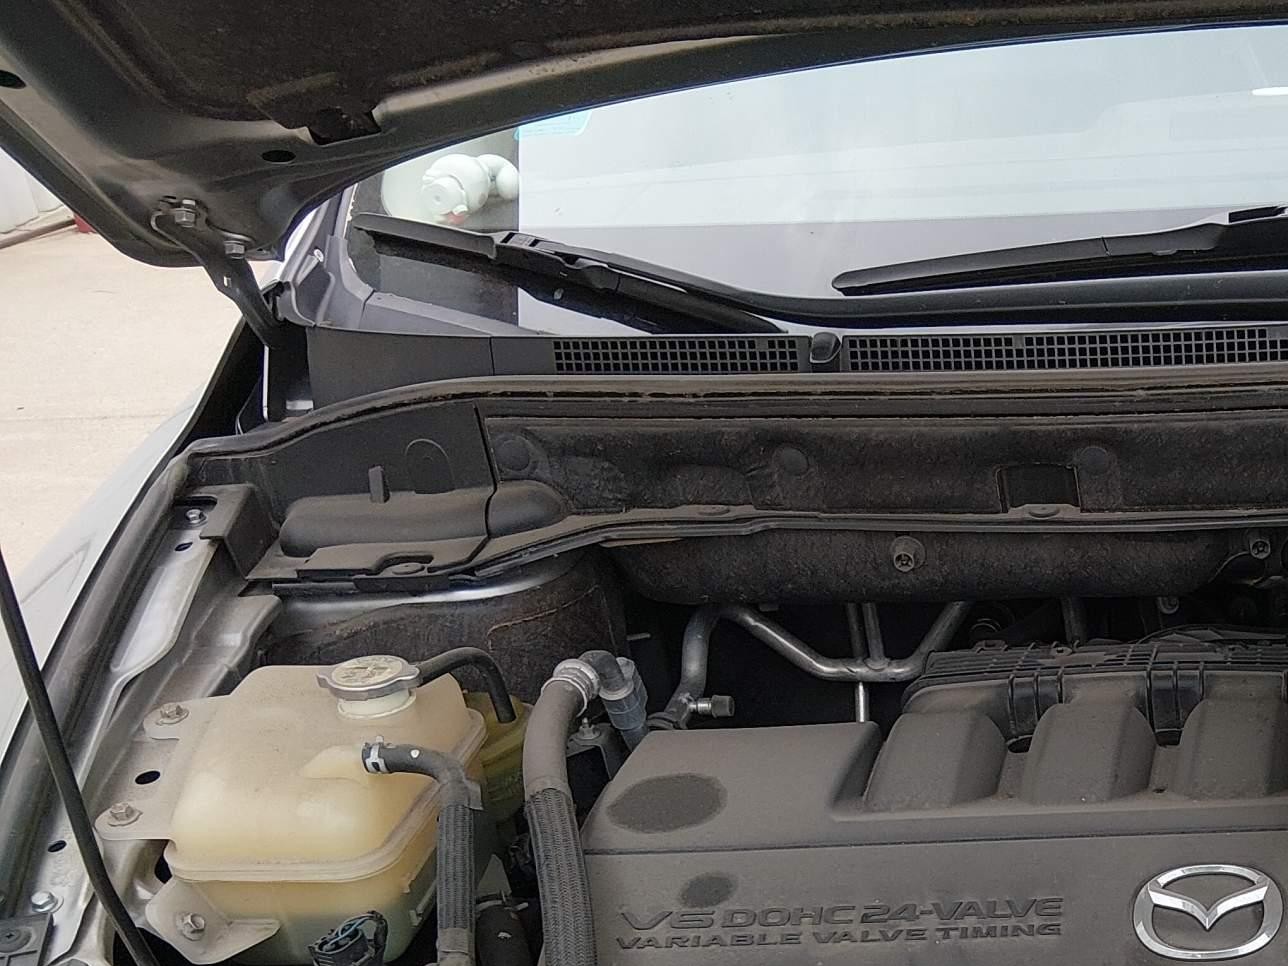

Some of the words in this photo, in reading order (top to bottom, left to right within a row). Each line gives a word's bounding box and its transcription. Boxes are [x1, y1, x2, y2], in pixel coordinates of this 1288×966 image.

[620, 909, 717, 932] V6
[720, 903, 857, 928] DOHC
[860, 897, 1064, 925] 24-VALVE
[616, 931, 803, 950] VARIABLE
[814, 927, 928, 944] VALVE
[936, 922, 1063, 941] TIMING
